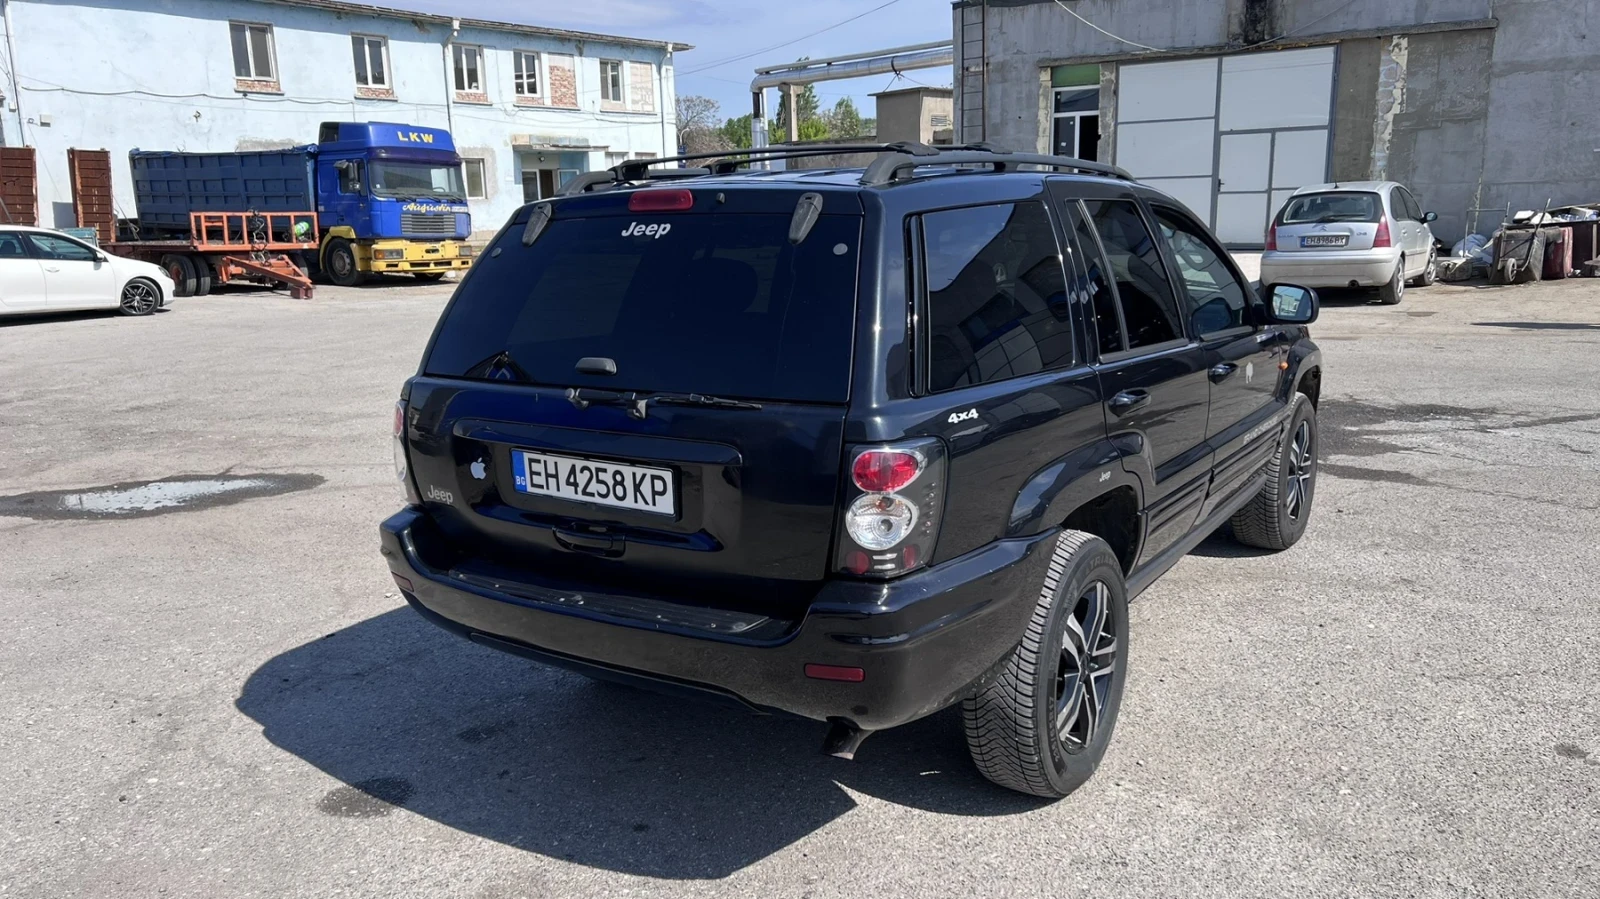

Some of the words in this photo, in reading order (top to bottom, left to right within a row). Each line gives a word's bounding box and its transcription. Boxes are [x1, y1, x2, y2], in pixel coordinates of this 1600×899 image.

[397, 131, 434, 144] LKW
[621, 221, 671, 239] Jeep
[947, 408, 979, 424] 4x4
[515, 475, 526, 486] BG
[527, 457, 561, 492] EH
[565, 463, 628, 502] 4258
[631, 471, 668, 507] KP
[427, 484, 453, 505] Jeep
